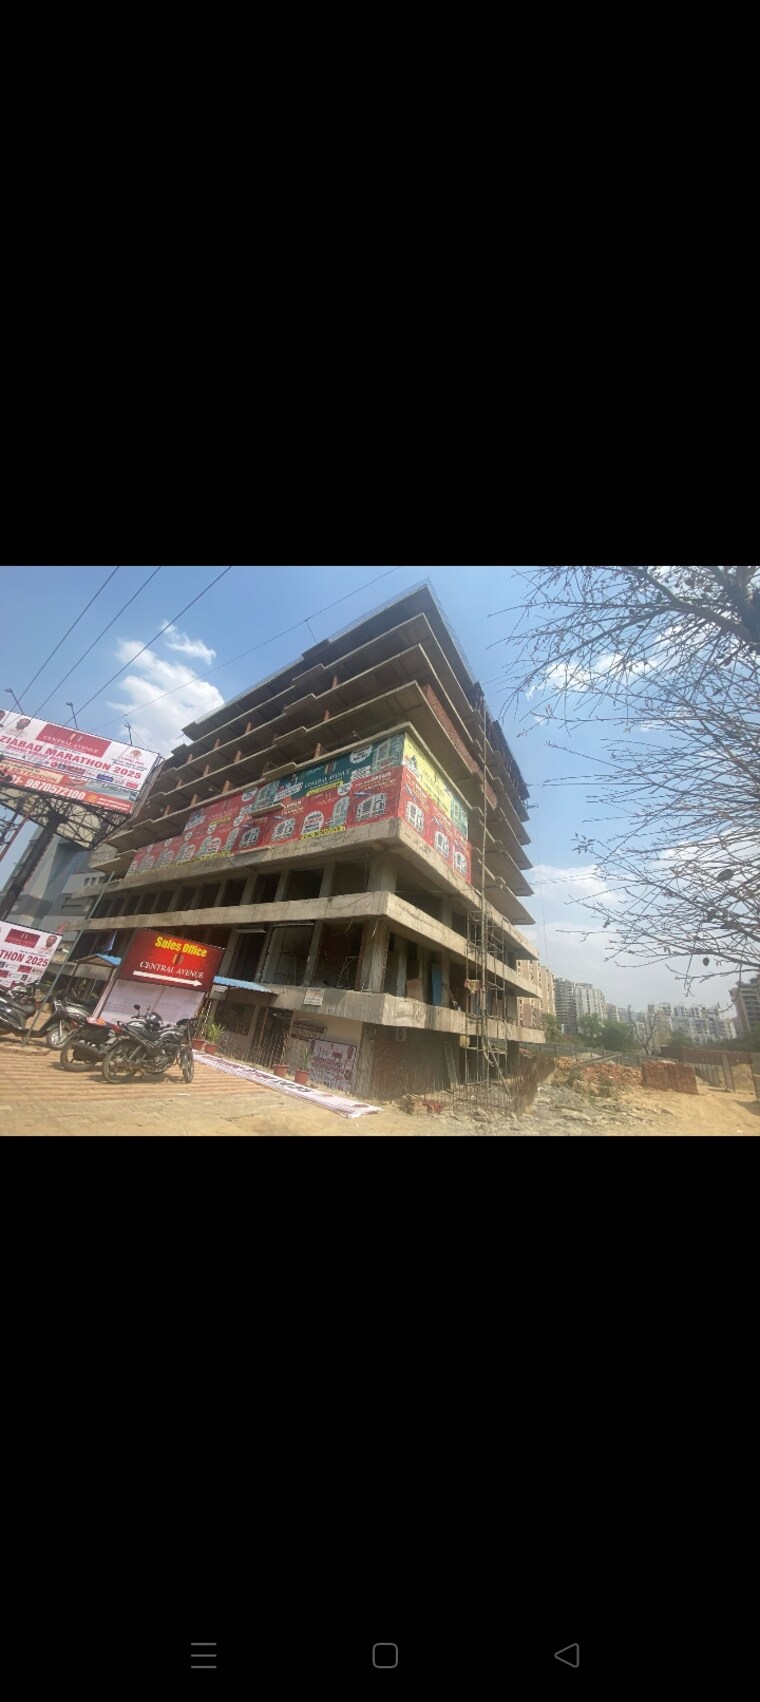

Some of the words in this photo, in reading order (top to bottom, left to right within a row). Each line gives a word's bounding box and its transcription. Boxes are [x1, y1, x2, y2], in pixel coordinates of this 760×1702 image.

[0, 735, 43, 752] ZIABAD
[45, 748, 111, 770] MARATHON
[113, 766, 142, 779] 2025
[155, 936, 181, 952] Sales
[182, 943, 208, 958] Office
[25, 955, 49, 967] 2025
[140, 961, 174, 973] CENTRAL
[176, 968, 204, 979] AVENUE
